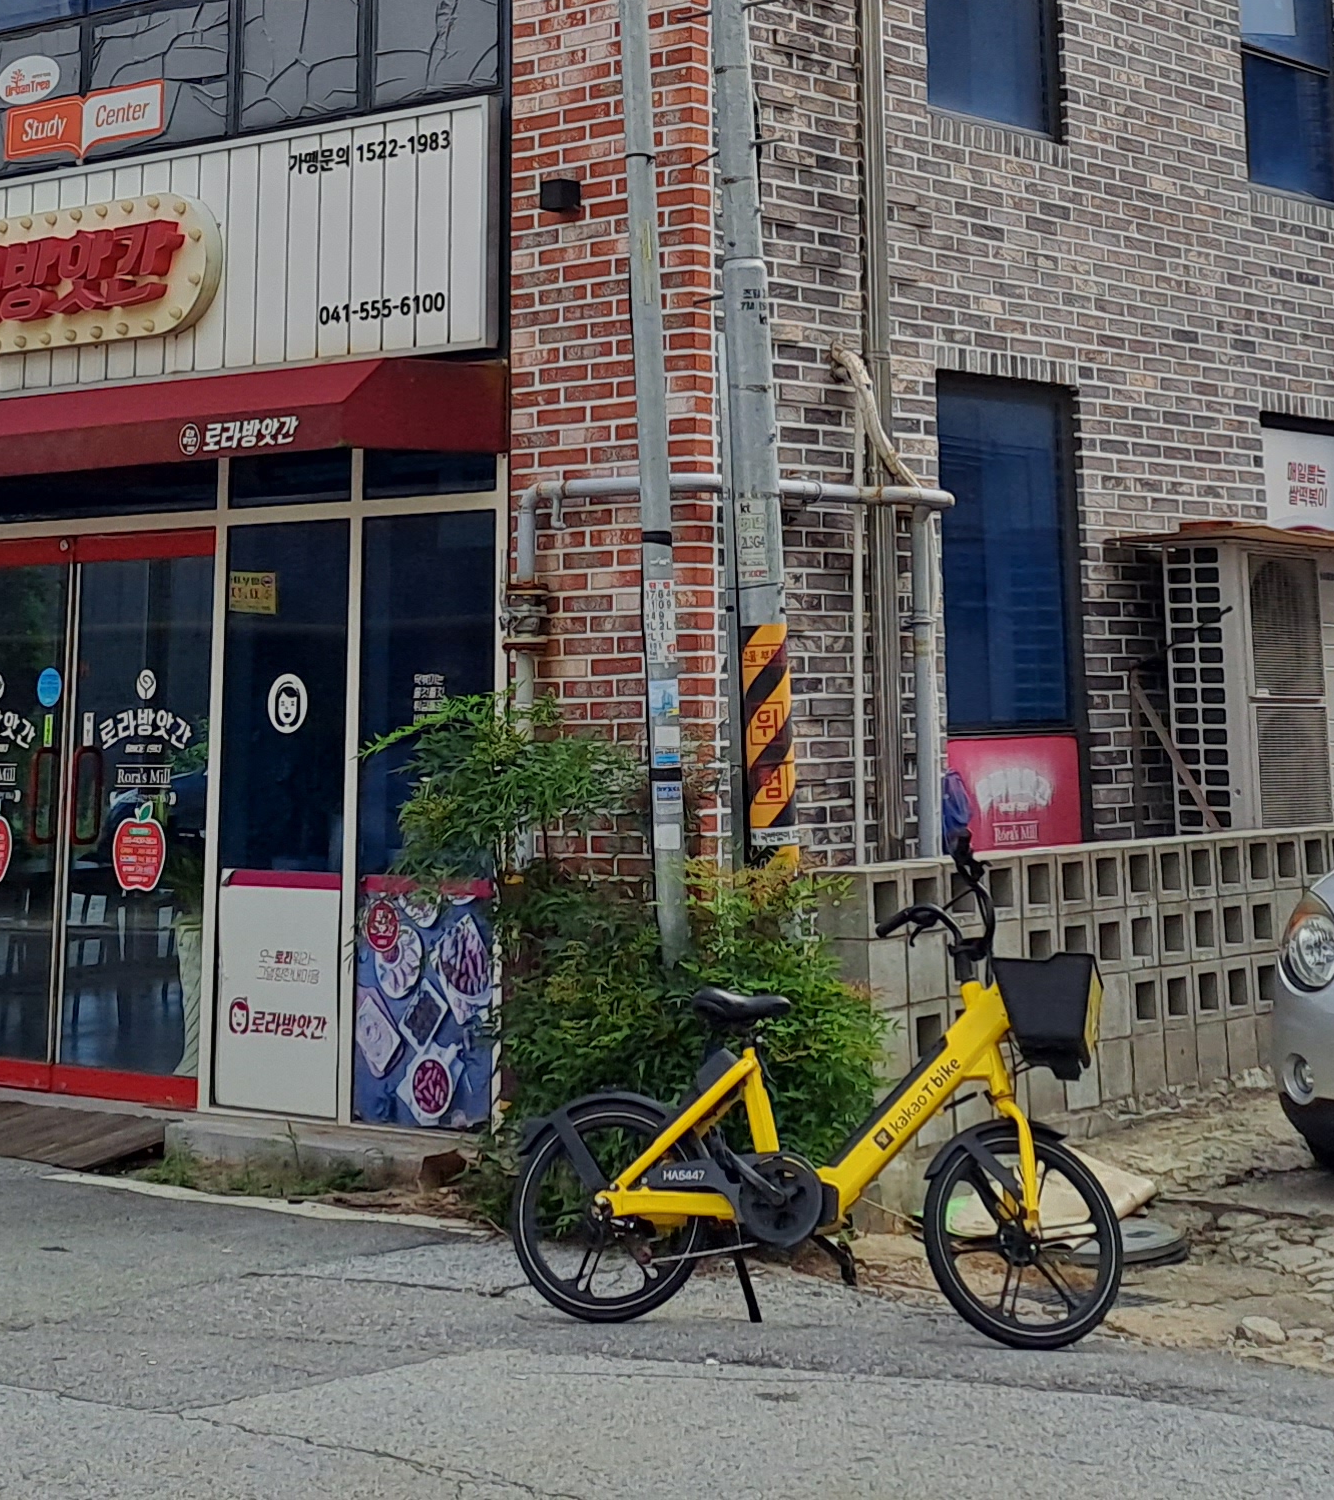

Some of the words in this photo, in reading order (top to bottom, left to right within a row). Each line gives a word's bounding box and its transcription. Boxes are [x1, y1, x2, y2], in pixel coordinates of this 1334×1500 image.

[22, 114, 67, 142] Study
[95, 101, 150, 128] Center
[289, 145, 350, 174] 가맹문의
[356, 130, 451, 162] 1522-1983
[319, 292, 446, 325] 041-555-6100
[202, 416, 299, 451] 로라방앗간
[99, 708, 193, 750] 로라방앗간
[118, 767, 147, 783] Rora's
[149, 768, 171, 784] Mill
[250, 1011, 327, 1041] 로라방앗간
[889, 1094, 928, 1135] kakao
[929, 1058, 962, 1089] bike
